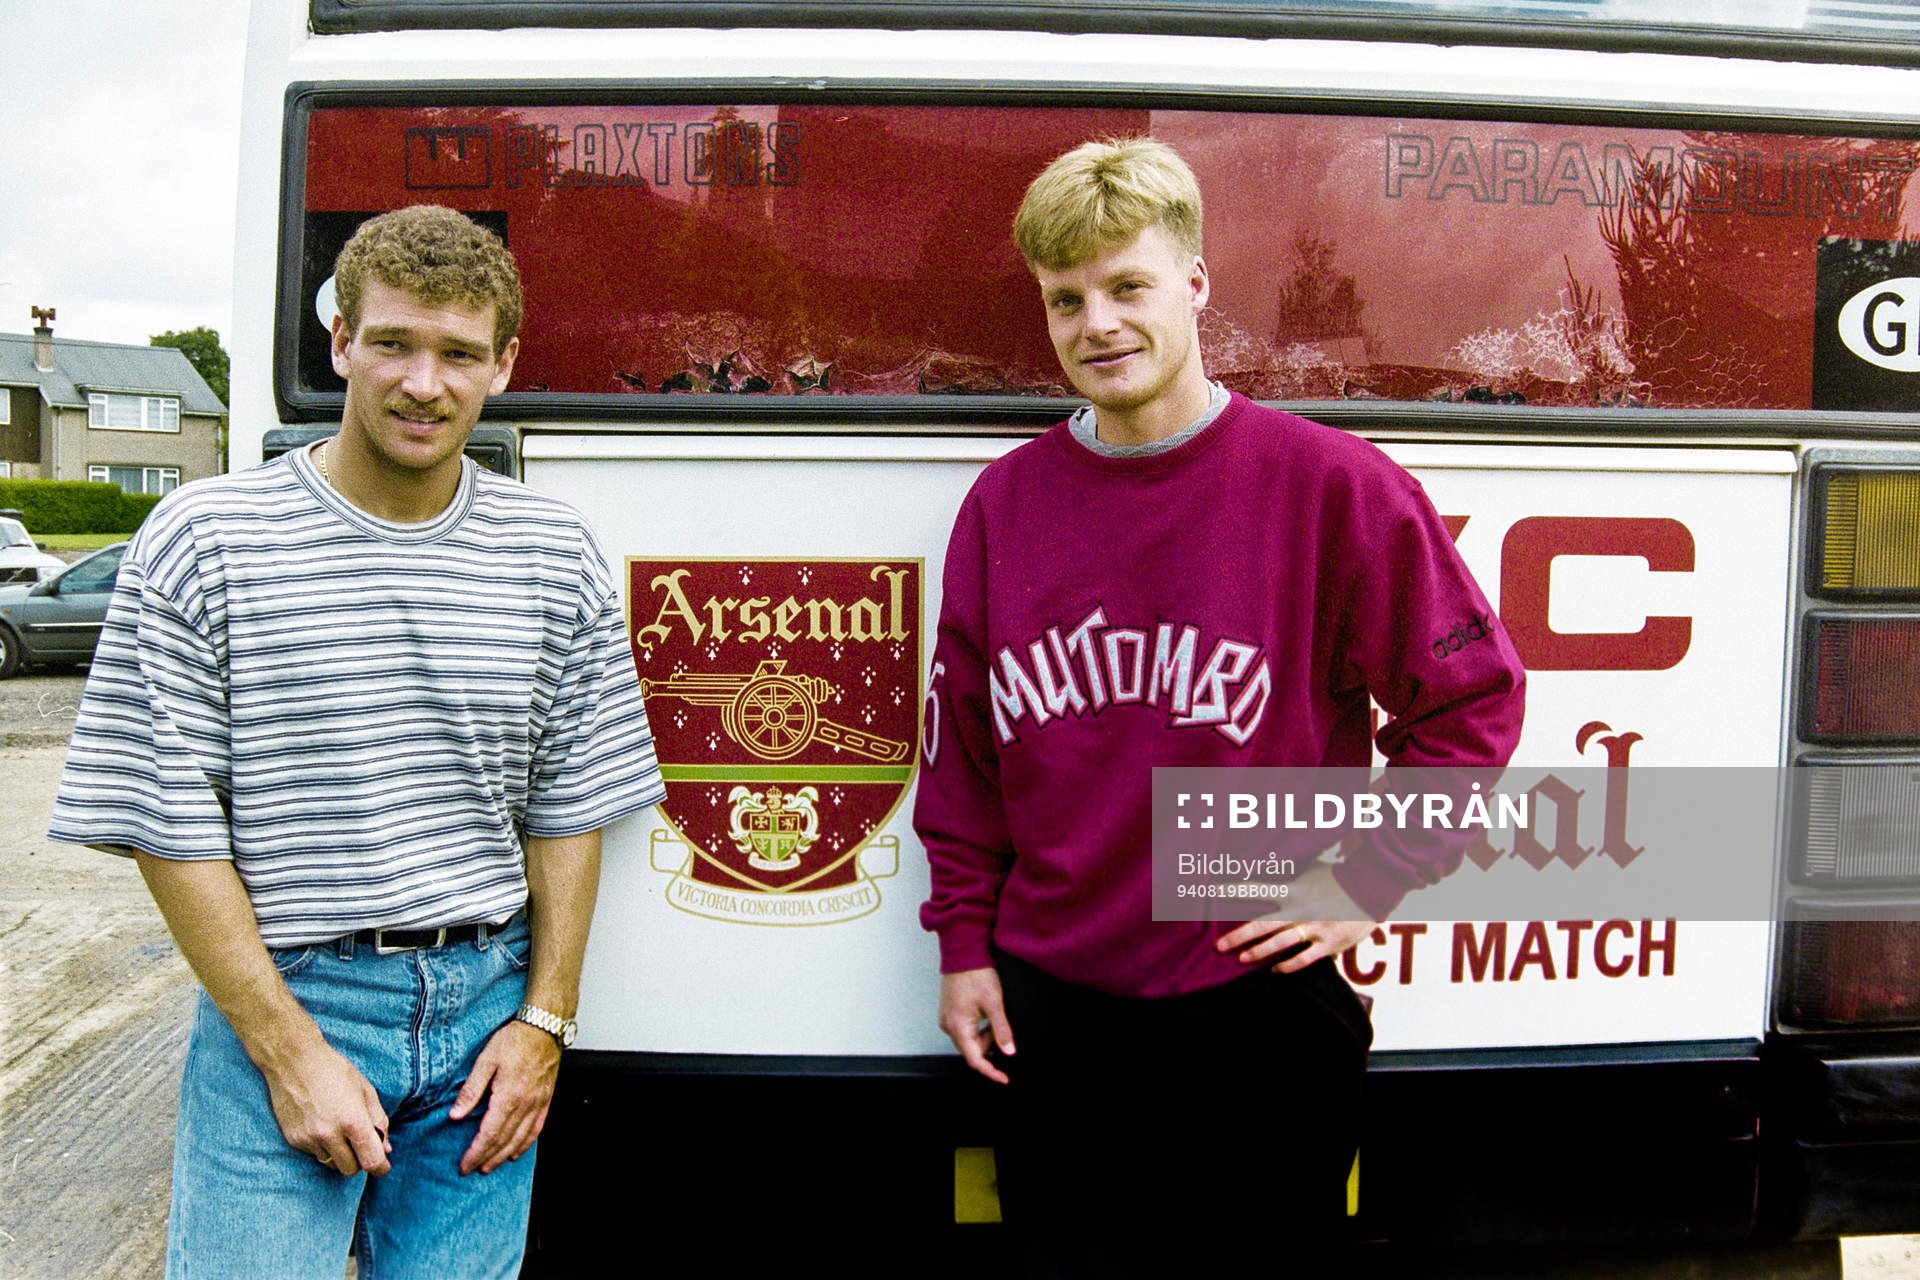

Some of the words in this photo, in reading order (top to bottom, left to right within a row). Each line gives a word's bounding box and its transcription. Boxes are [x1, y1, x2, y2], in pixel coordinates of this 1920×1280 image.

[505, 121, 801, 189] PLAXTONS
[1385, 133, 1915, 221] PARAMOUNT
[1862, 291, 1920, 358] G
[636, 564, 911, 651] Arsenal
[1438, 515, 1696, 671] C
[988, 604, 1272, 749] MUTOMBO
[676, 881, 737, 913] VICTORIA
[739, 898, 816, 917] CONCORDIA
[818, 887, 874, 914] CRESCIT
[1333, 923, 1428, 986] CT
[1450, 918, 1677, 983] MATCH
